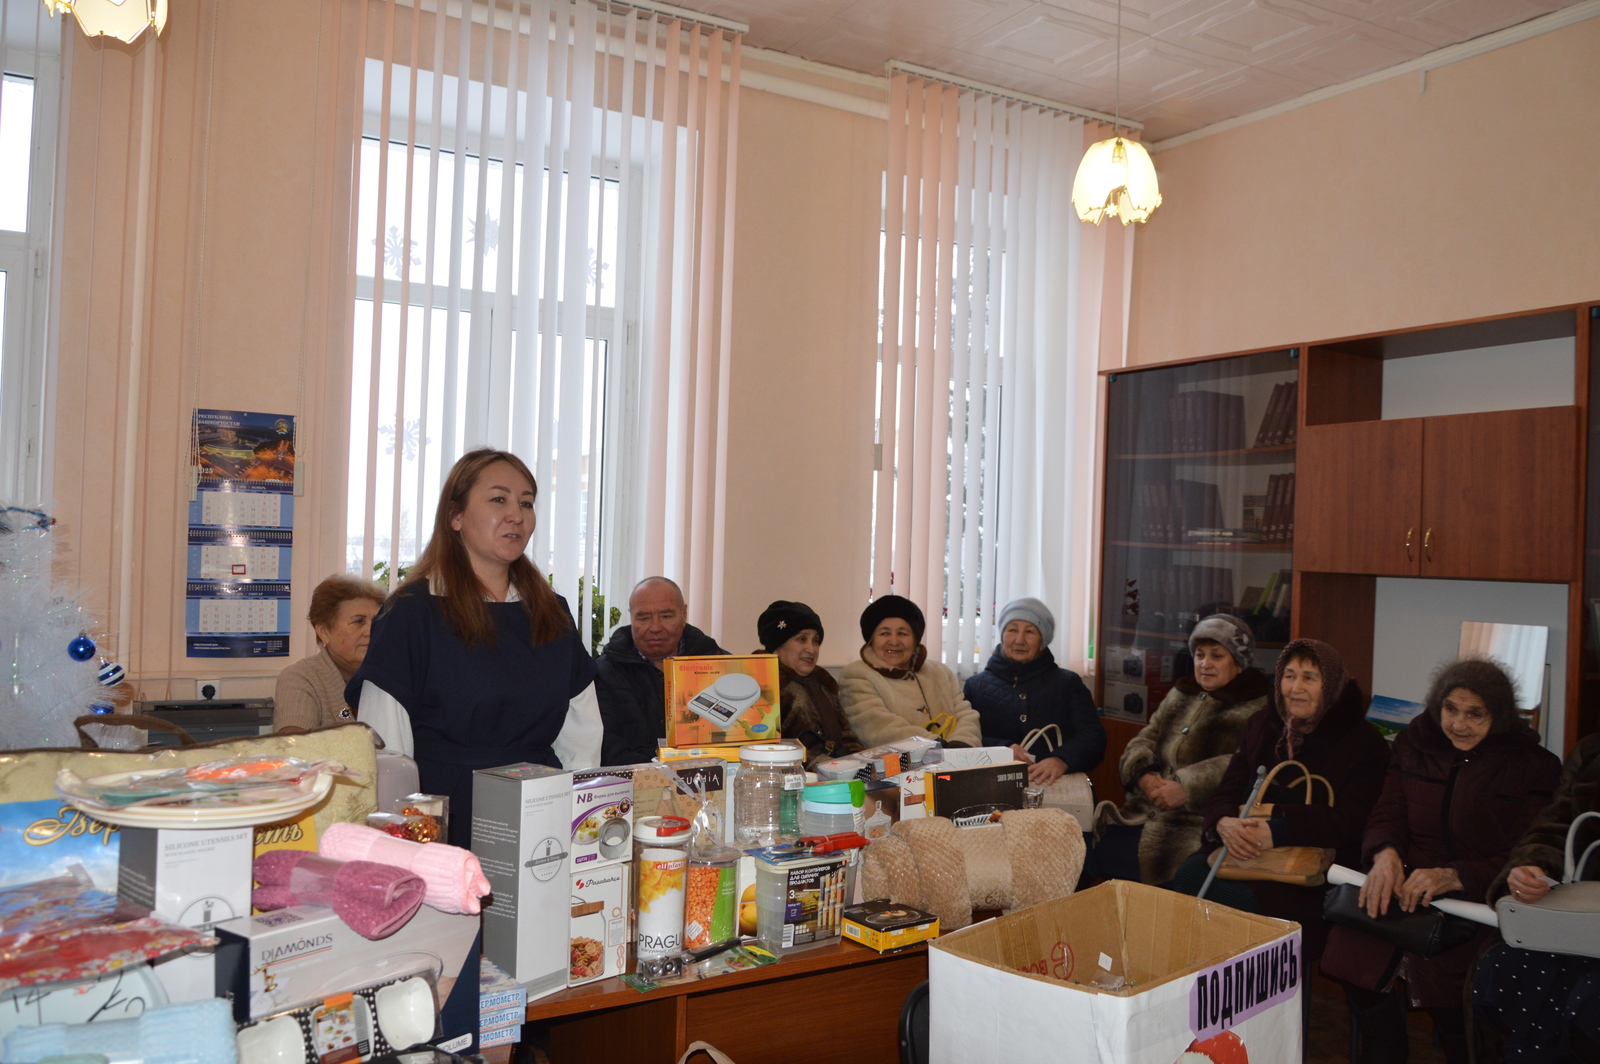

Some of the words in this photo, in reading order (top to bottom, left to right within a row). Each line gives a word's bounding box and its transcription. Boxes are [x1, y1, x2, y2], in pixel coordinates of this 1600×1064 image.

[546, 792, 564, 800] UTENSILS
[576, 792, 593, 804] NB
[164, 841, 199, 851] SILICONE
[201, 836, 235, 846] UTENSILS
[805, 865, 830, 873] КОНТЕЙНЕРОВ
[789, 890, 795, 899] 3
[262, 934, 333, 961] DIAMONDS
[1197, 939, 1297, 1031] ПОДПИШИСЬ
[480, 993, 520, 1008] ЕРМОМЕТР
[480, 1012, 518, 1027] ЕРМОМЕТР
[480, 1029, 514, 1042] РМОМЕТР
[444, 1037, 468, 1051] OLUME
